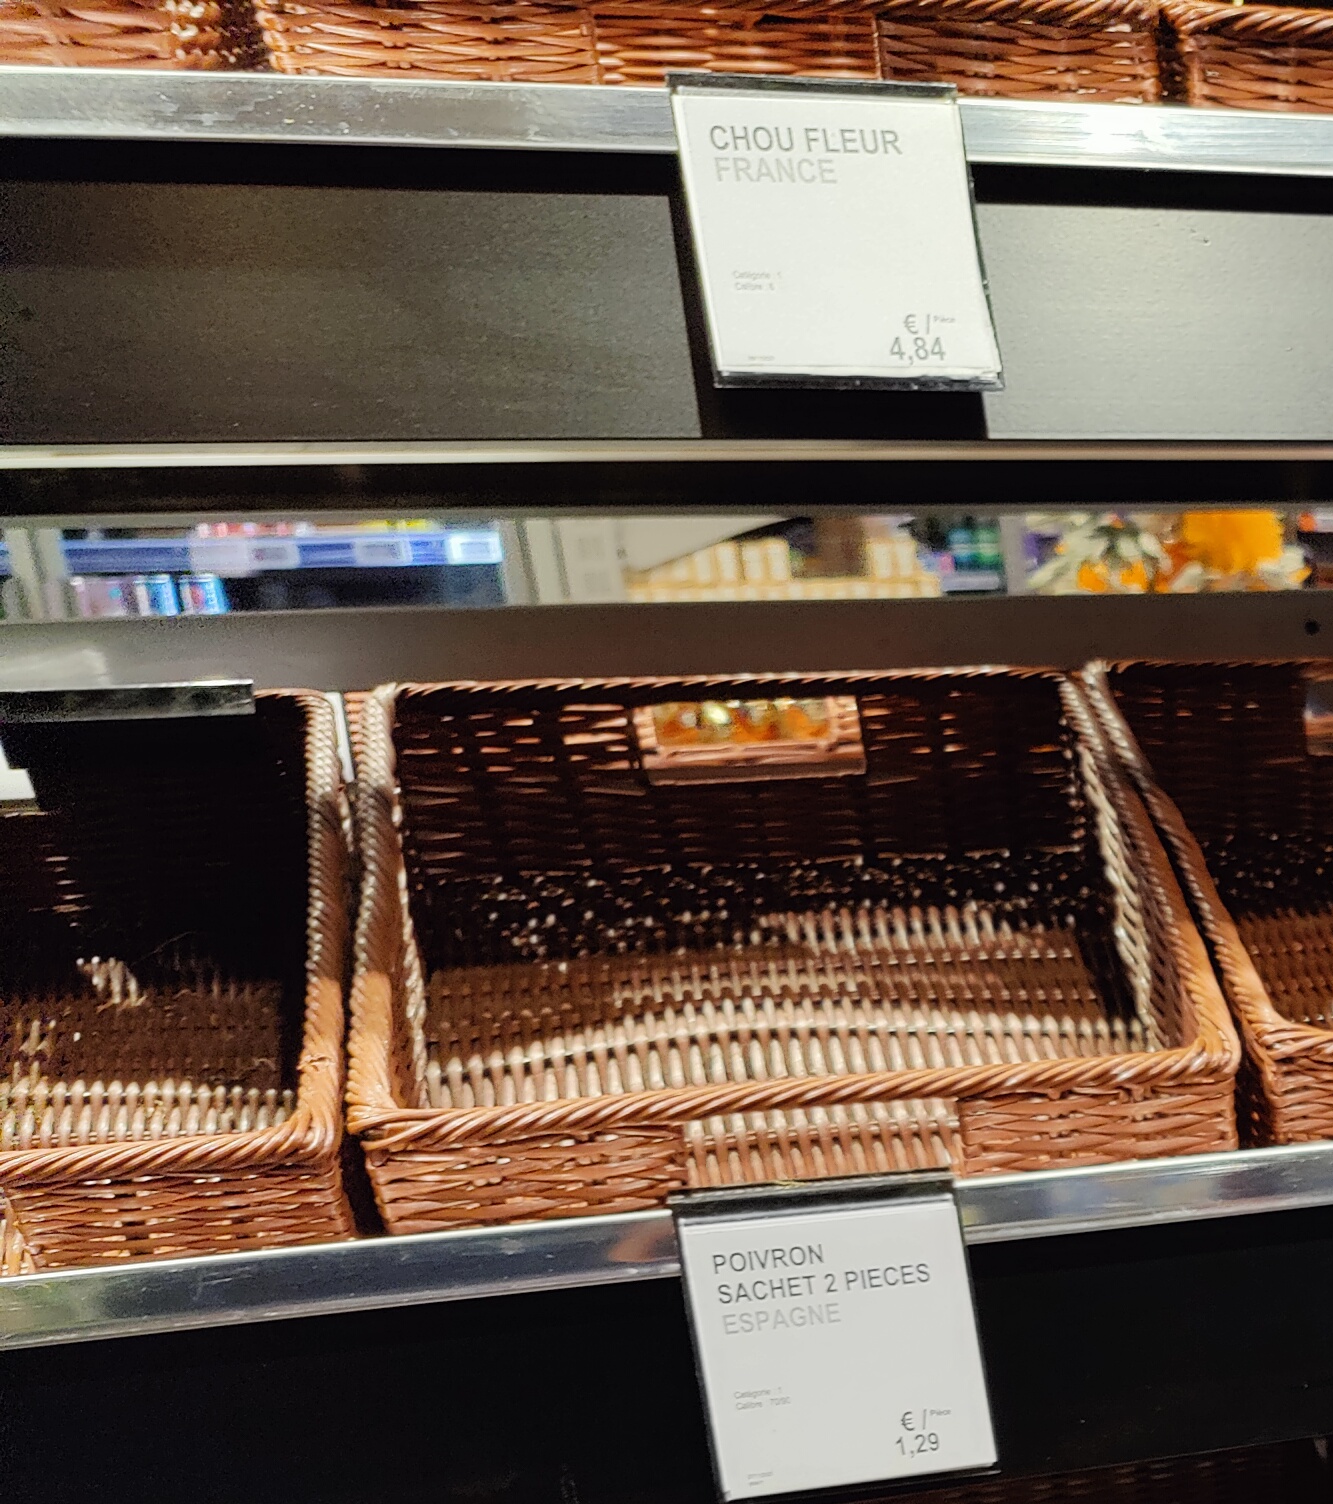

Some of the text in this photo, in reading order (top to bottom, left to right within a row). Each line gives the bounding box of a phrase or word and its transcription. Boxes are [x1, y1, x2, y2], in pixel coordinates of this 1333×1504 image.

[709, 125, 902, 155] CHOU FLEUR
[715, 157, 837, 184] FRANCE
[889, 336, 946, 366] 4,84
[712, 1243, 824, 1274] POIVRON
[718, 1263, 931, 1304] SACHET 2 PIECES
[722, 1303, 842, 1335] ESPAGNE
[895, 1432, 939, 1458] 1,29
